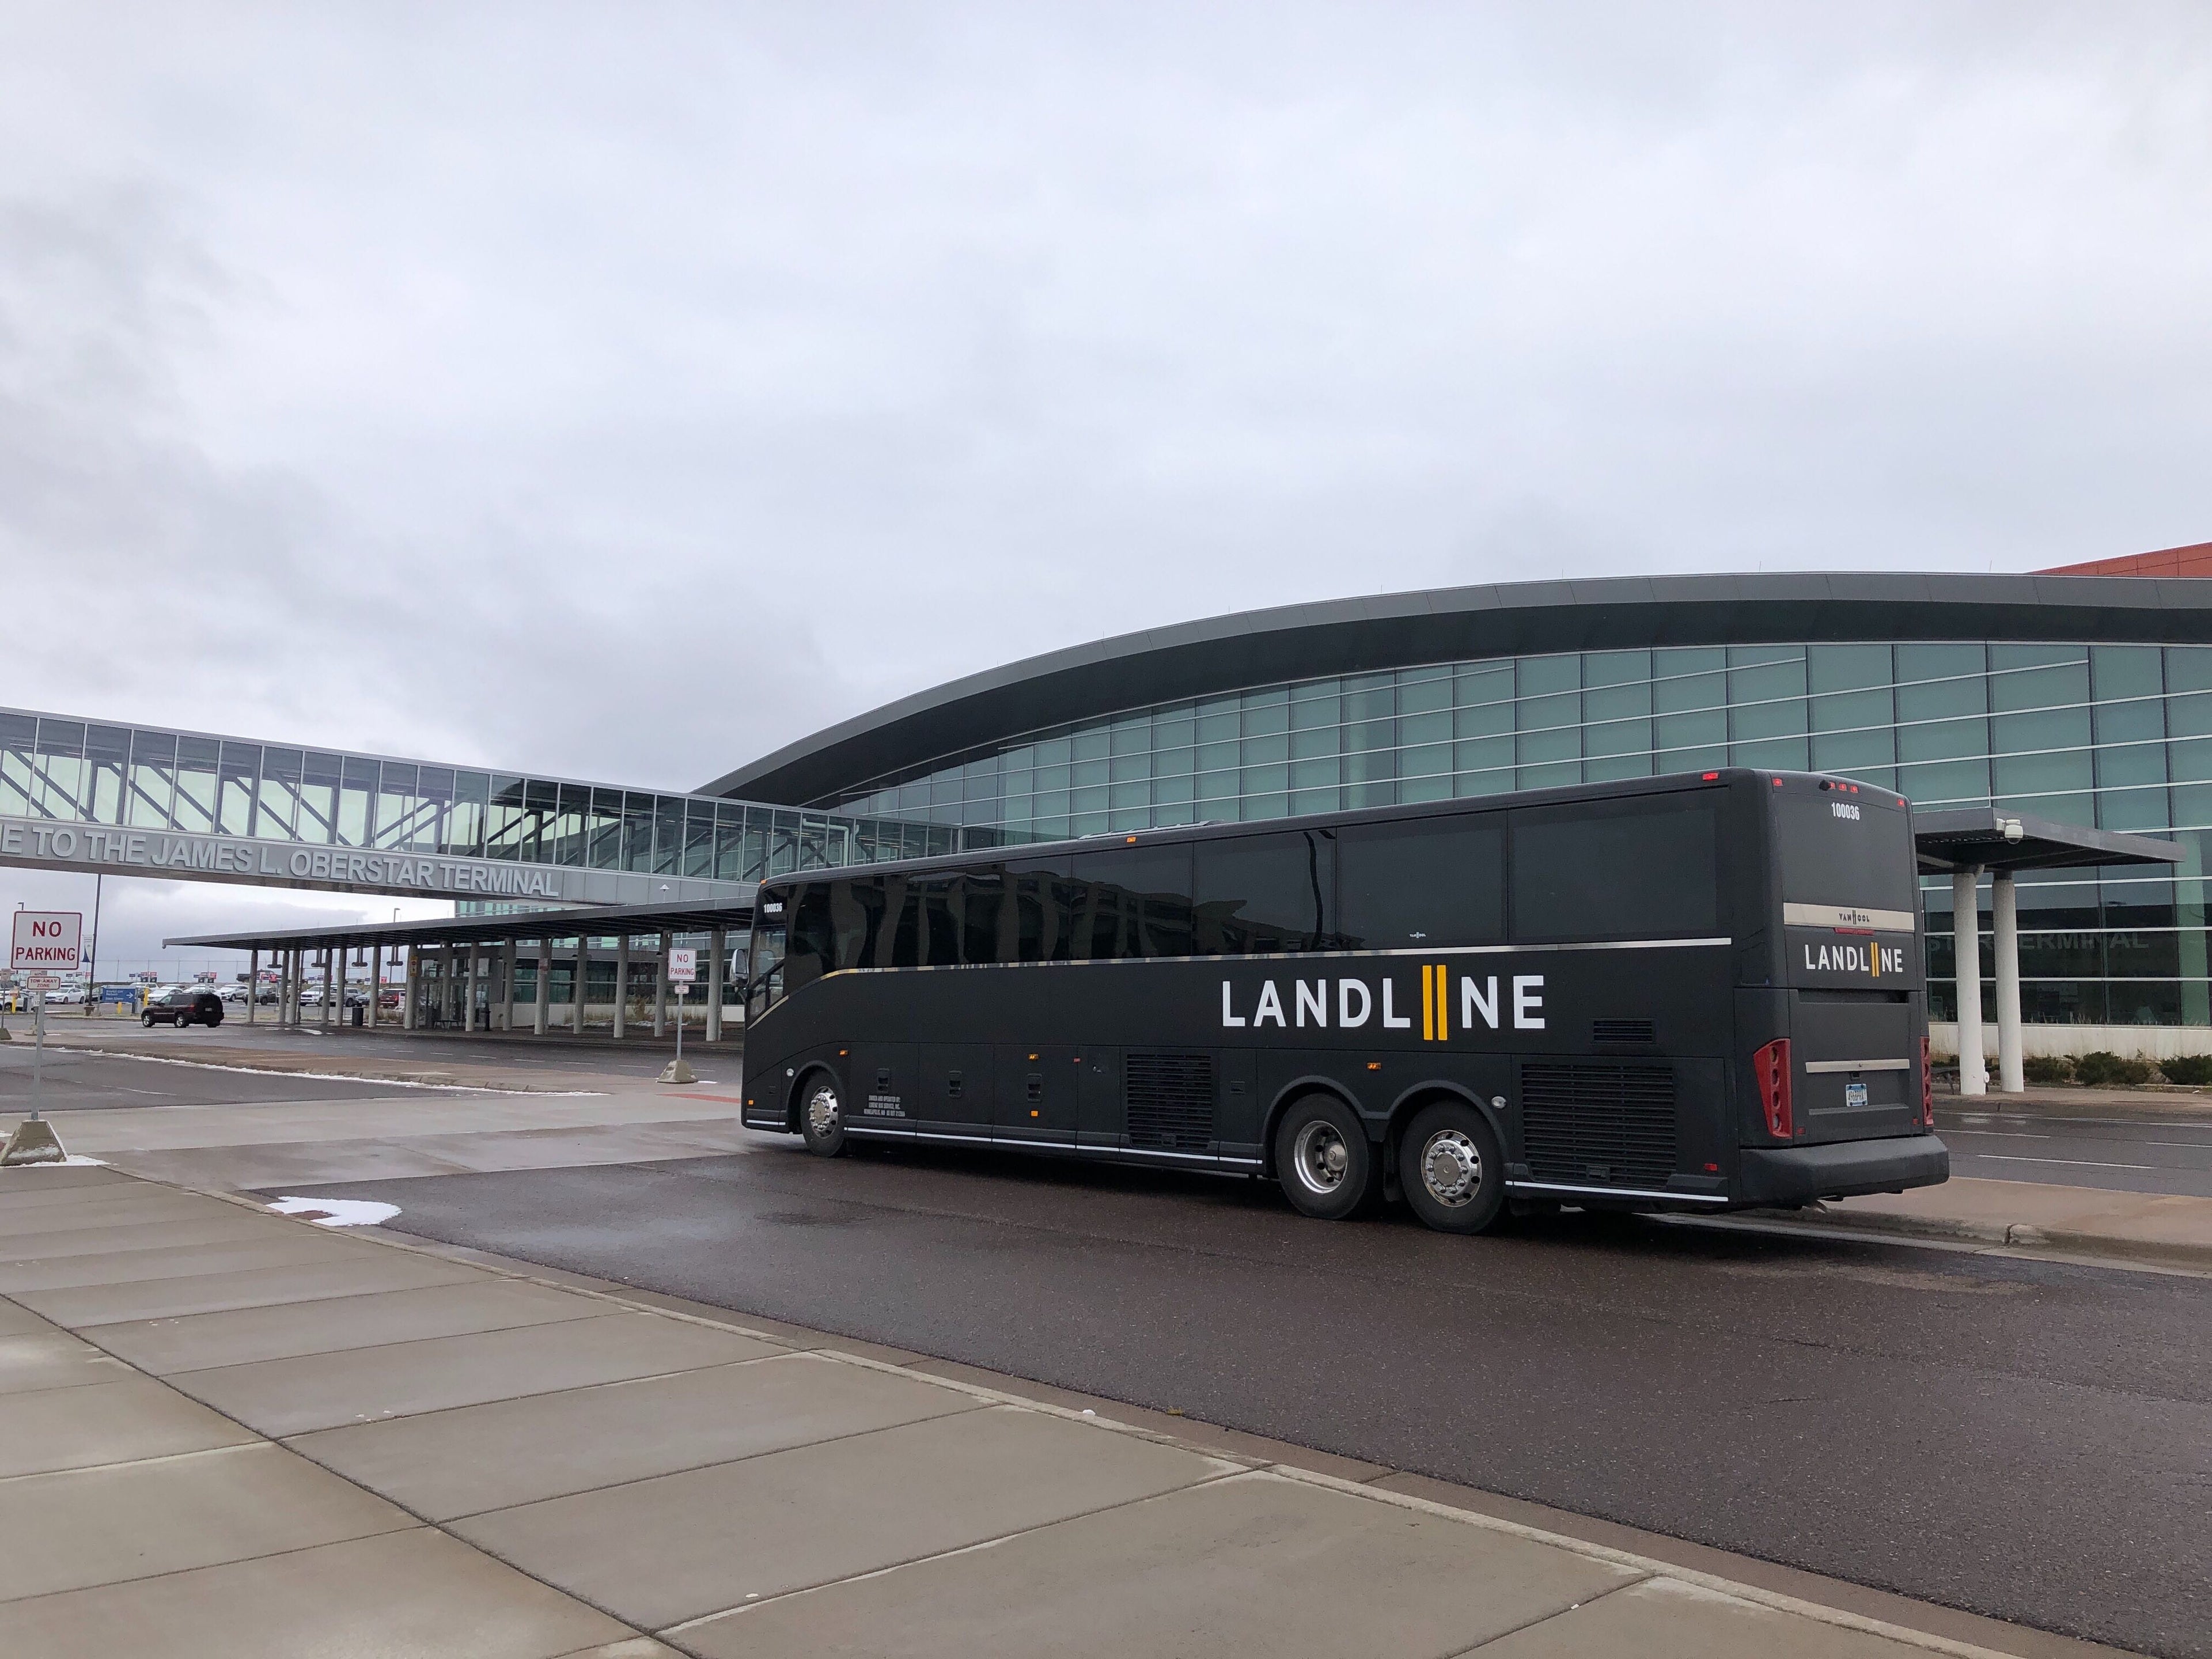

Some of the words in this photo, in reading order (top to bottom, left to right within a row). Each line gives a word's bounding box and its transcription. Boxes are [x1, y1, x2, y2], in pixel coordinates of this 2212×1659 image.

[1832, 802, 1860, 821] 100036
[0, 824, 24, 854] E
[32, 826, 77, 857] TO
[85, 831, 146, 863] THE
[151, 838, 253, 872] JAMES
[260, 847, 282, 874] L.
[290, 850, 433, 887] OBERSTAR
[439, 863, 559, 896] TERMINAL
[764, 903, 782, 913] 100036
[32, 921, 62, 937] NO
[16, 947, 75, 961] PARKING
[677, 954, 688, 963] NO
